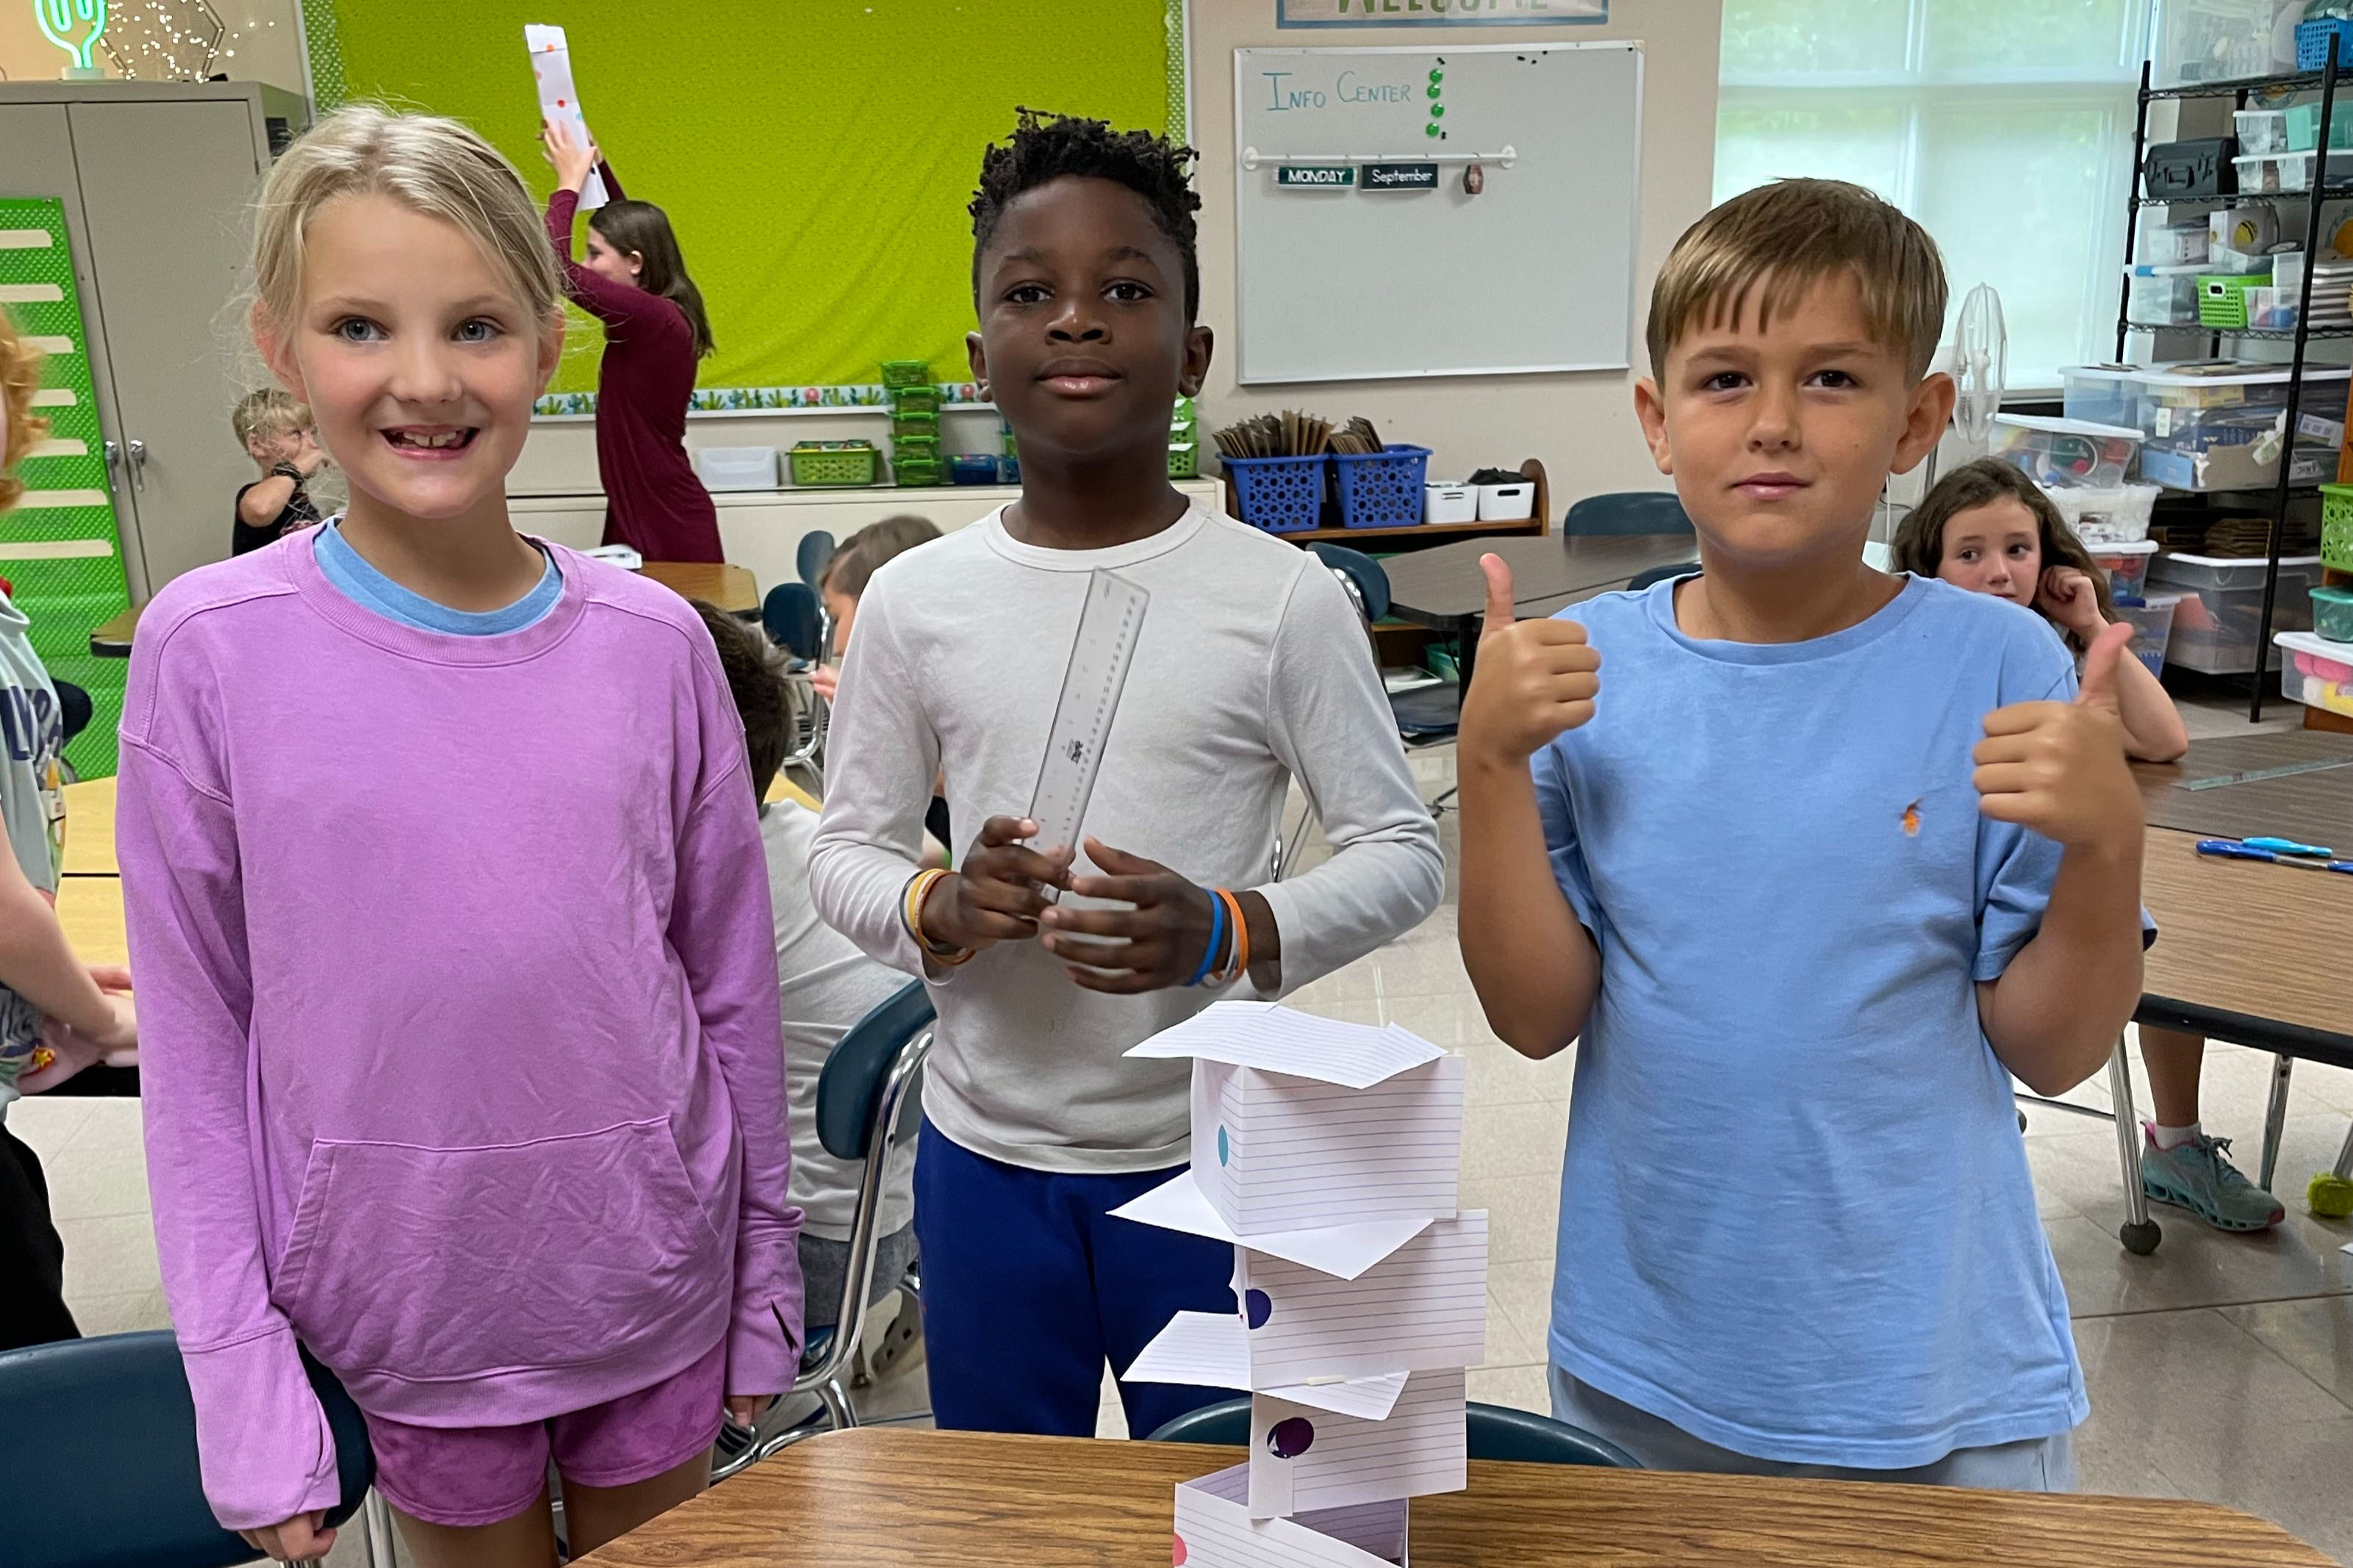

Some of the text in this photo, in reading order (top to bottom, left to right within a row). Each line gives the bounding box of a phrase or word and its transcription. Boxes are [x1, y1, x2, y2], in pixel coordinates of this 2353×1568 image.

[1262, 70, 1412, 111] INFO CENTER
[1287, 170, 1346, 183] MONDAY
[1371, 168, 1433, 185] September
